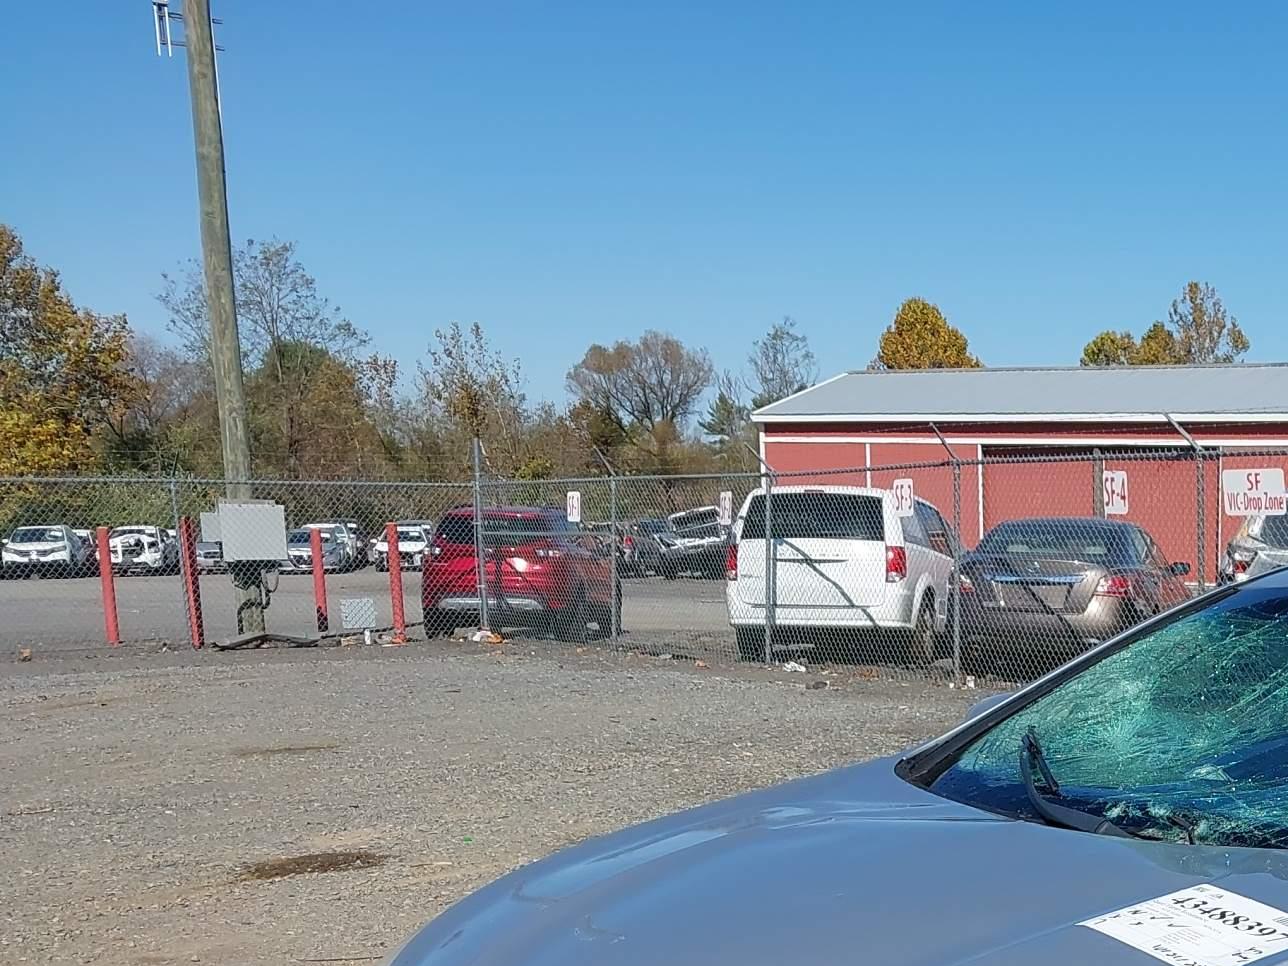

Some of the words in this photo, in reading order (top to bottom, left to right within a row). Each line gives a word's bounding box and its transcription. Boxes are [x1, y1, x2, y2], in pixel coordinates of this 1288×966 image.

[1245, 472, 1261, 490] SF
[894, 483, 913, 511] SF-3
[1104, 476, 1127, 511] SF-4
[1226, 492, 1264, 513] VIC-Drop
[1264, 493, 1285, 513] Zone
